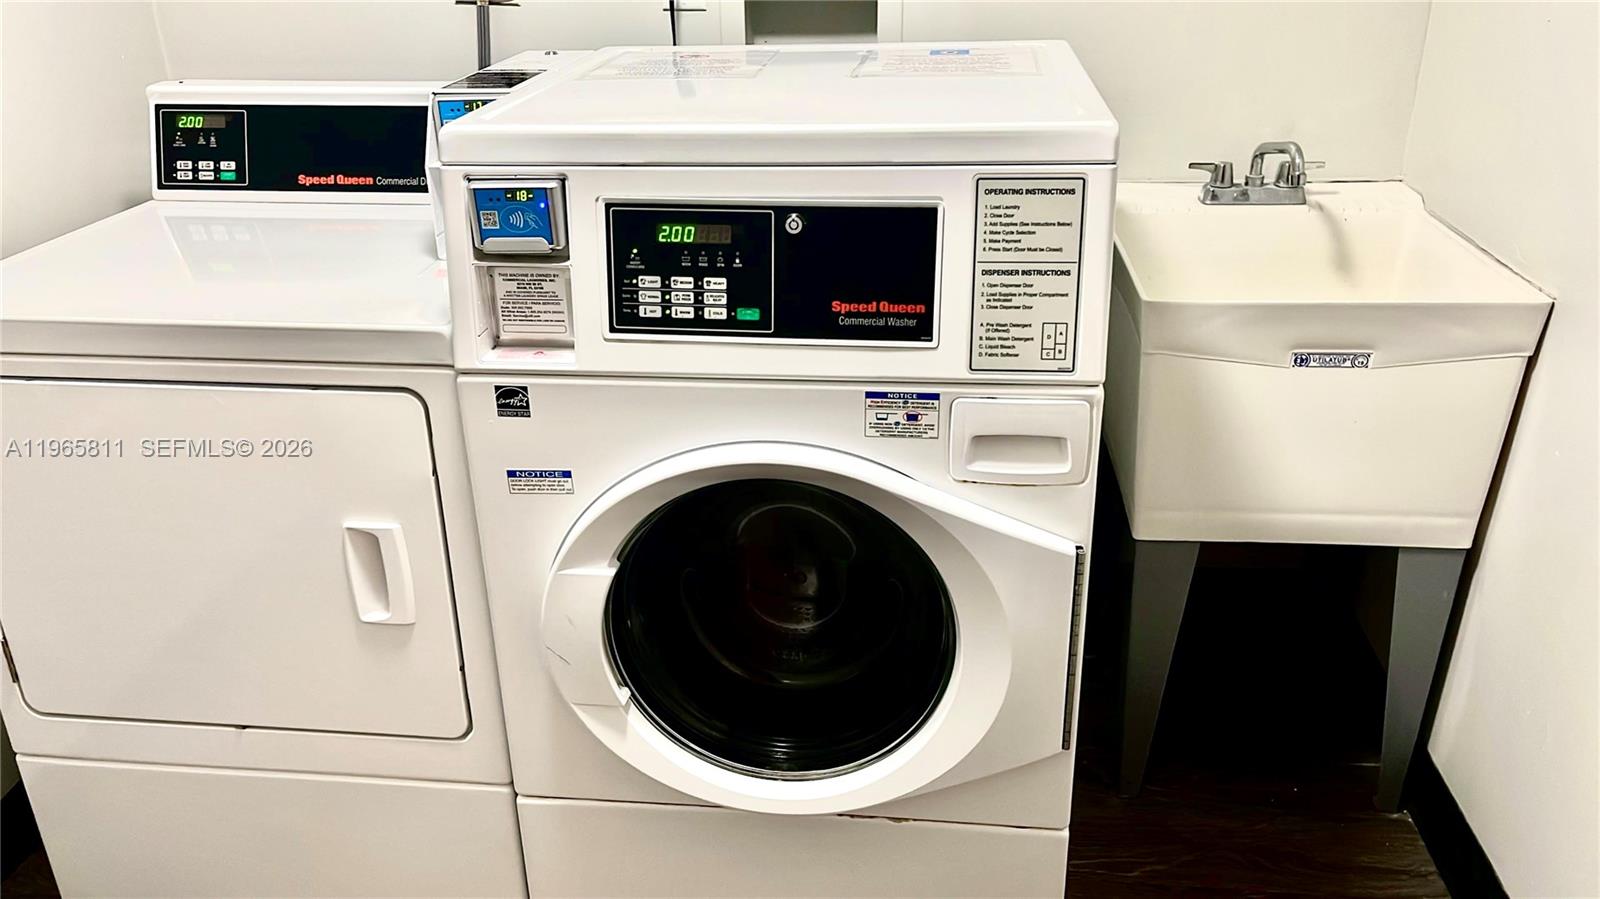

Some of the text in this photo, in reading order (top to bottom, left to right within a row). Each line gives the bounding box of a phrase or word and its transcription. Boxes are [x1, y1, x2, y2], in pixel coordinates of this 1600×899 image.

[179, 116, 203, 128] 2.00
[298, 174, 334, 186] Speed
[336, 174, 373, 185] Queen
[376, 176, 418, 185] Commercial
[658, 226, 695, 242] 2.00
[832, 301, 925, 313] Speed Queen
[838, 316, 917, 326] Commercial Washer
